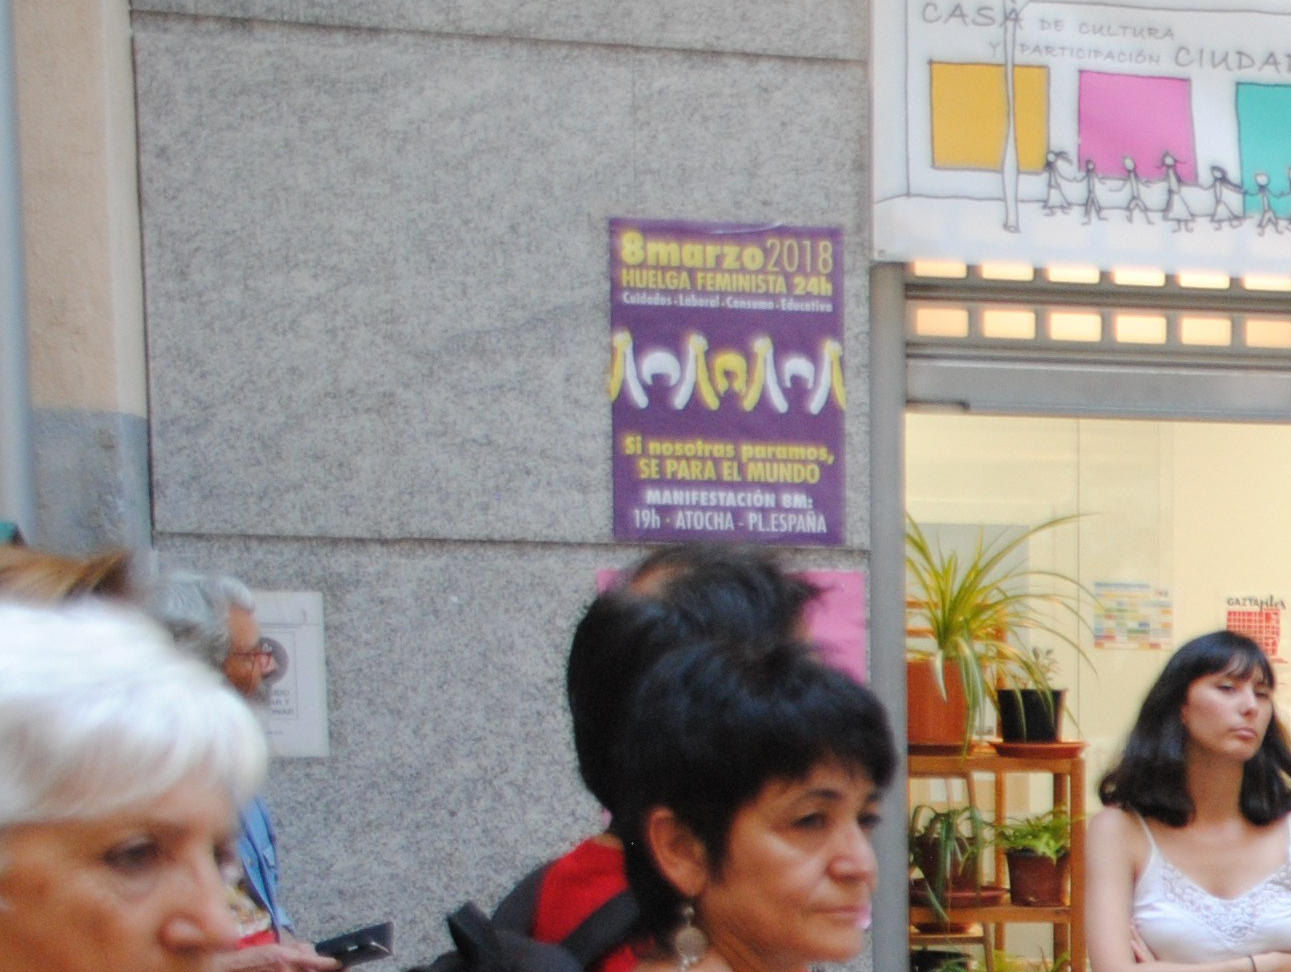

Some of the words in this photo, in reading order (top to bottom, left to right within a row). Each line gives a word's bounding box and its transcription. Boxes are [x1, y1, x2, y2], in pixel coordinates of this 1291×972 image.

[921, 2, 1024, 30] CASA
[1040, 19, 1065, 32] DE
[1079, 22, 1177, 42] CULTURA
[1018, 41, 1161, 66] PARTICIPACIÓN
[621, 269, 692, 291] HUELGA
[696, 272, 788, 295] FEMINISTA
[793, 275, 834, 297] 24h
[622, 291, 673, 307] Cuidados
[678, 295, 720, 309] Laboral
[725, 297, 775, 311] Consumo
[624, 435, 643, 456] Si
[648, 440, 736, 459] nosotras
[740, 443, 836, 466] paramos,
[639, 458, 660, 480] SE
[665, 459, 718, 481] PARA
[721, 460, 742, 482] EL
[747, 462, 822, 485] MUNDO
[646, 487, 776, 509] MANIFESTACIÓN
[781, 493, 813, 509] 8M:
[634, 508, 661, 529] 19h
[675, 510, 735, 531] ATOCHA
[748, 509, 828, 534] PL.ESPAÑA
